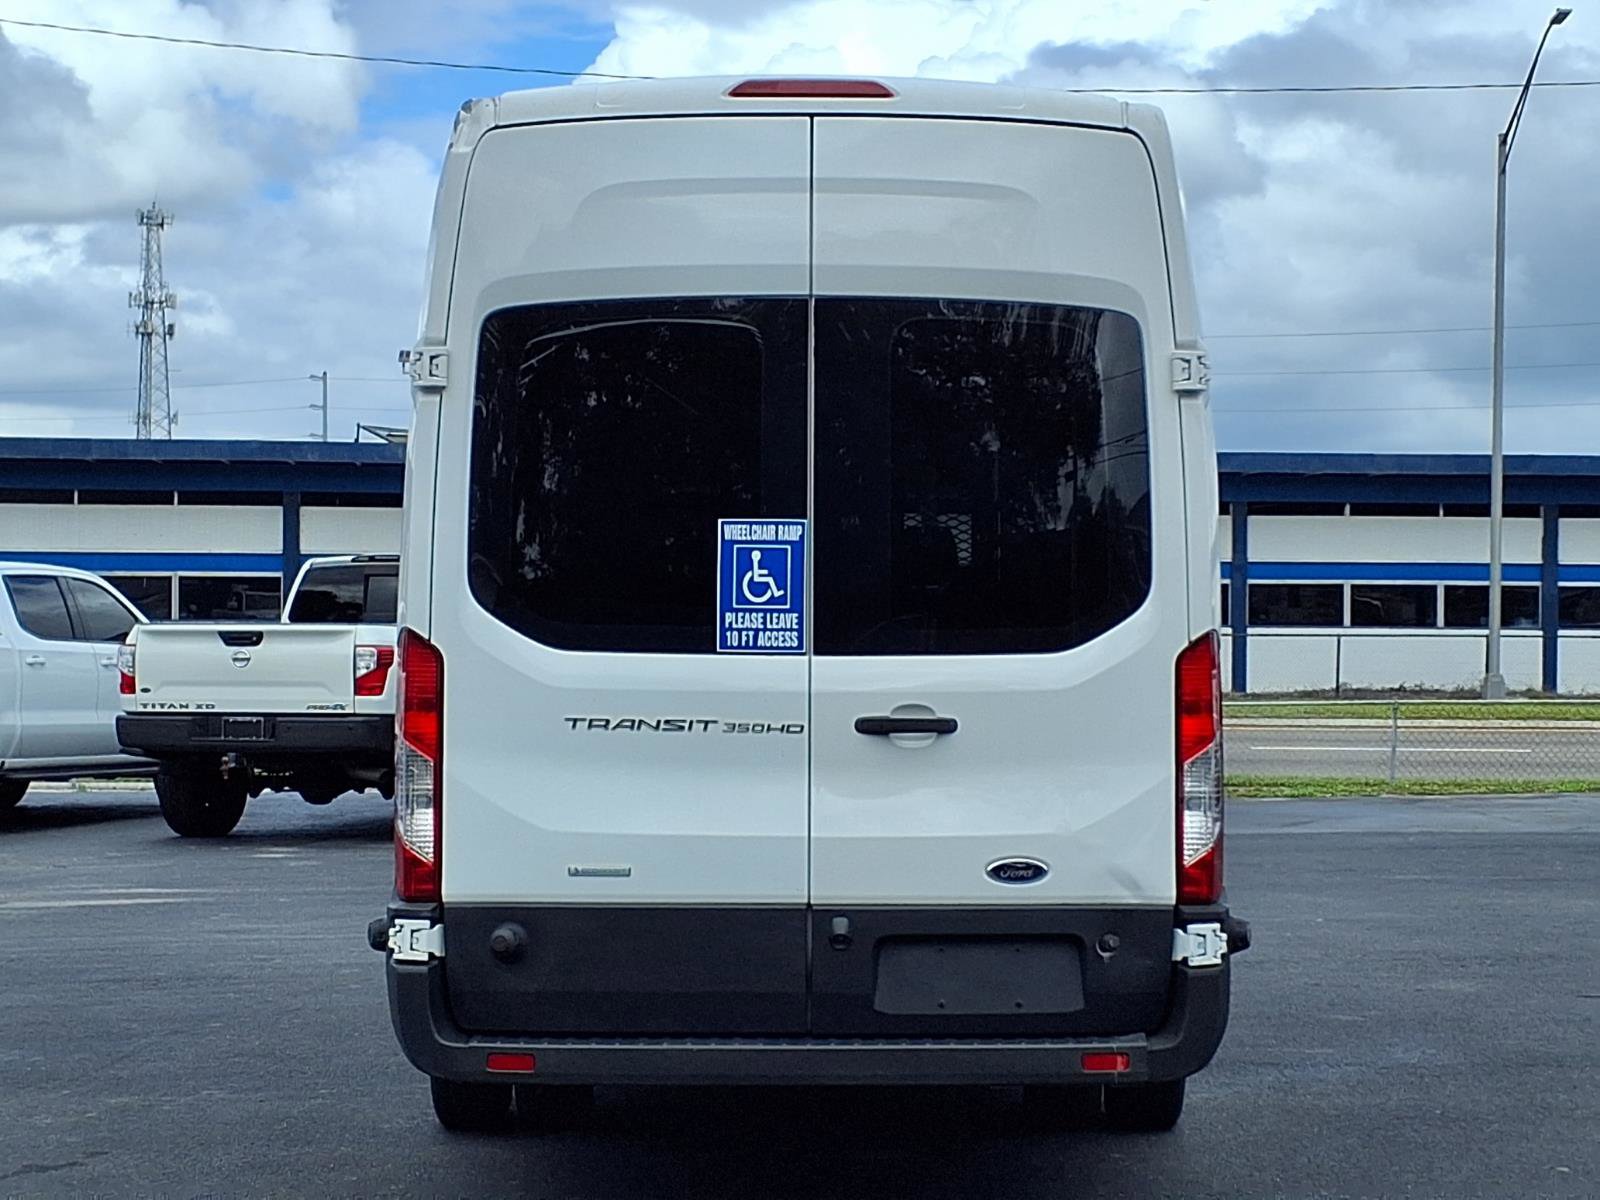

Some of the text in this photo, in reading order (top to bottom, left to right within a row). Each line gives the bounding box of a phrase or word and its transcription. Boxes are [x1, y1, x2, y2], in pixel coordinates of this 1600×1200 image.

[724, 524, 803, 541] WHEELCHAIR RAMP
[725, 612, 799, 629] PLEASE LEAVE
[726, 631, 799, 647] 10 FT ACCESS
[140, 702, 190, 710] TITAN
[564, 717, 805, 735] TRANSIT 350HD
